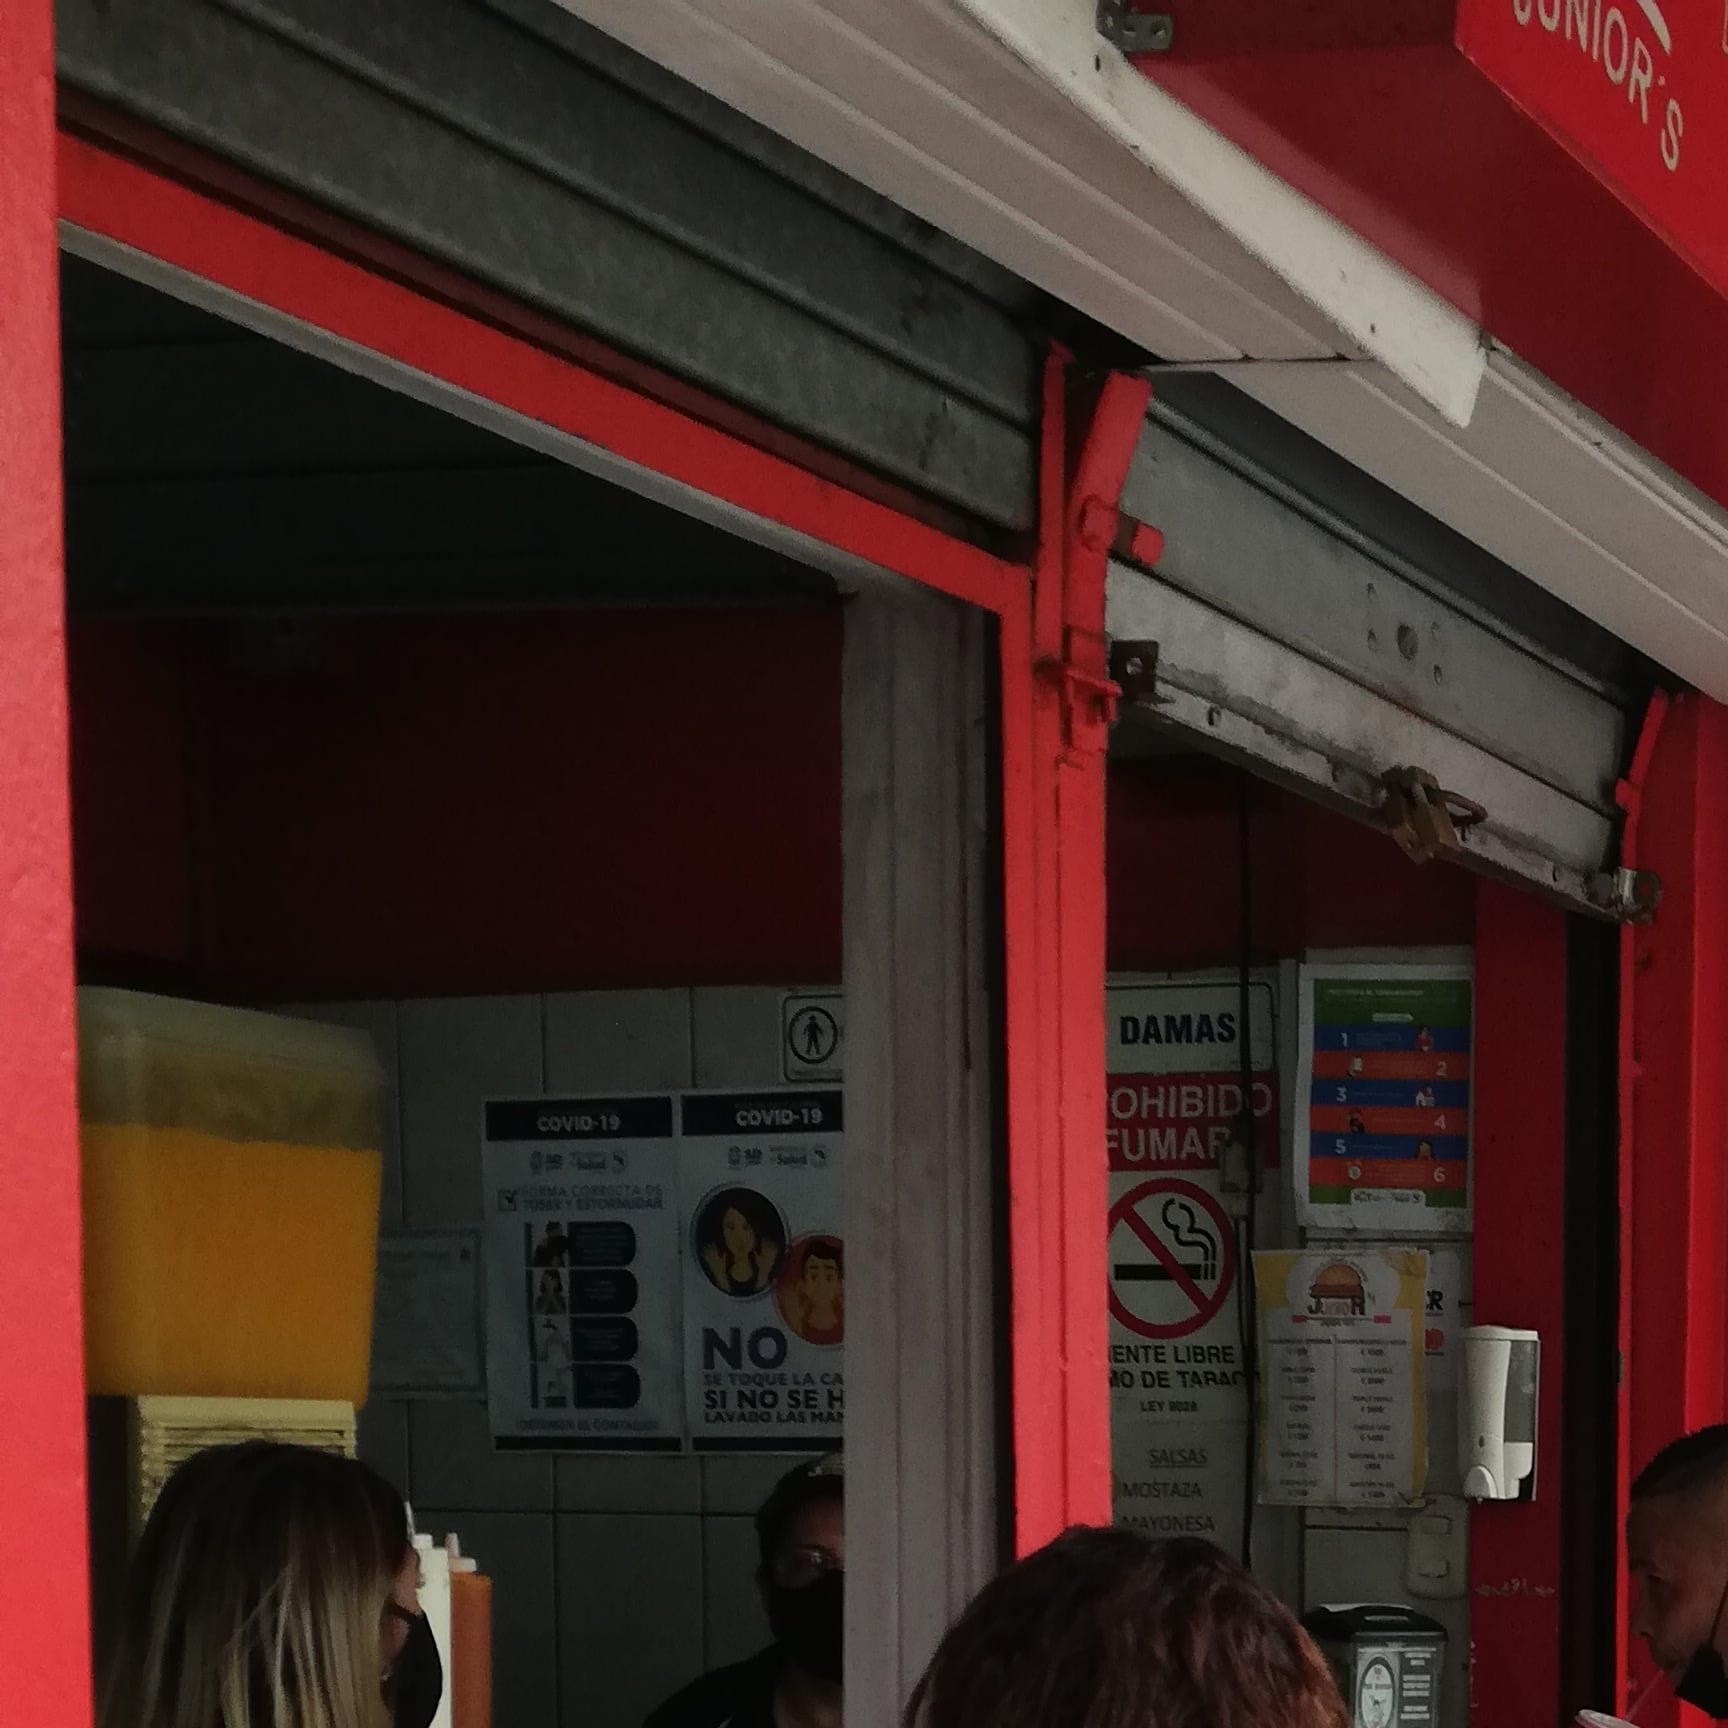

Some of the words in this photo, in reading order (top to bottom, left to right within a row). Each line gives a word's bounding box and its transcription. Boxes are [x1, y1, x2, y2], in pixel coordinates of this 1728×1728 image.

[1120, 1013, 1236, 1045] DAMAS
[536, 1115, 622, 1134] COVID-19
[735, 1107, 824, 1127] COVID-19
[703, 1327, 788, 1370] NO
[1173, 1345, 1235, 1364] LIBRE
[729, 1373, 788, 1389] TOQUE
[792, 1373, 814, 1387] LA
[1142, 1371, 1170, 1389] DE
[704, 1390, 726, 1411] SI
[737, 1389, 778, 1411] NO
[787, 1389, 819, 1411] SE
[1140, 1401, 1164, 1413] LEY
[704, 1411, 773, 1424] LAVADO
[777, 1411, 806, 1424] LAS
[1149, 1448, 1208, 1465] SALSAS
[1122, 1482, 1204, 1499] MOSTAZA
